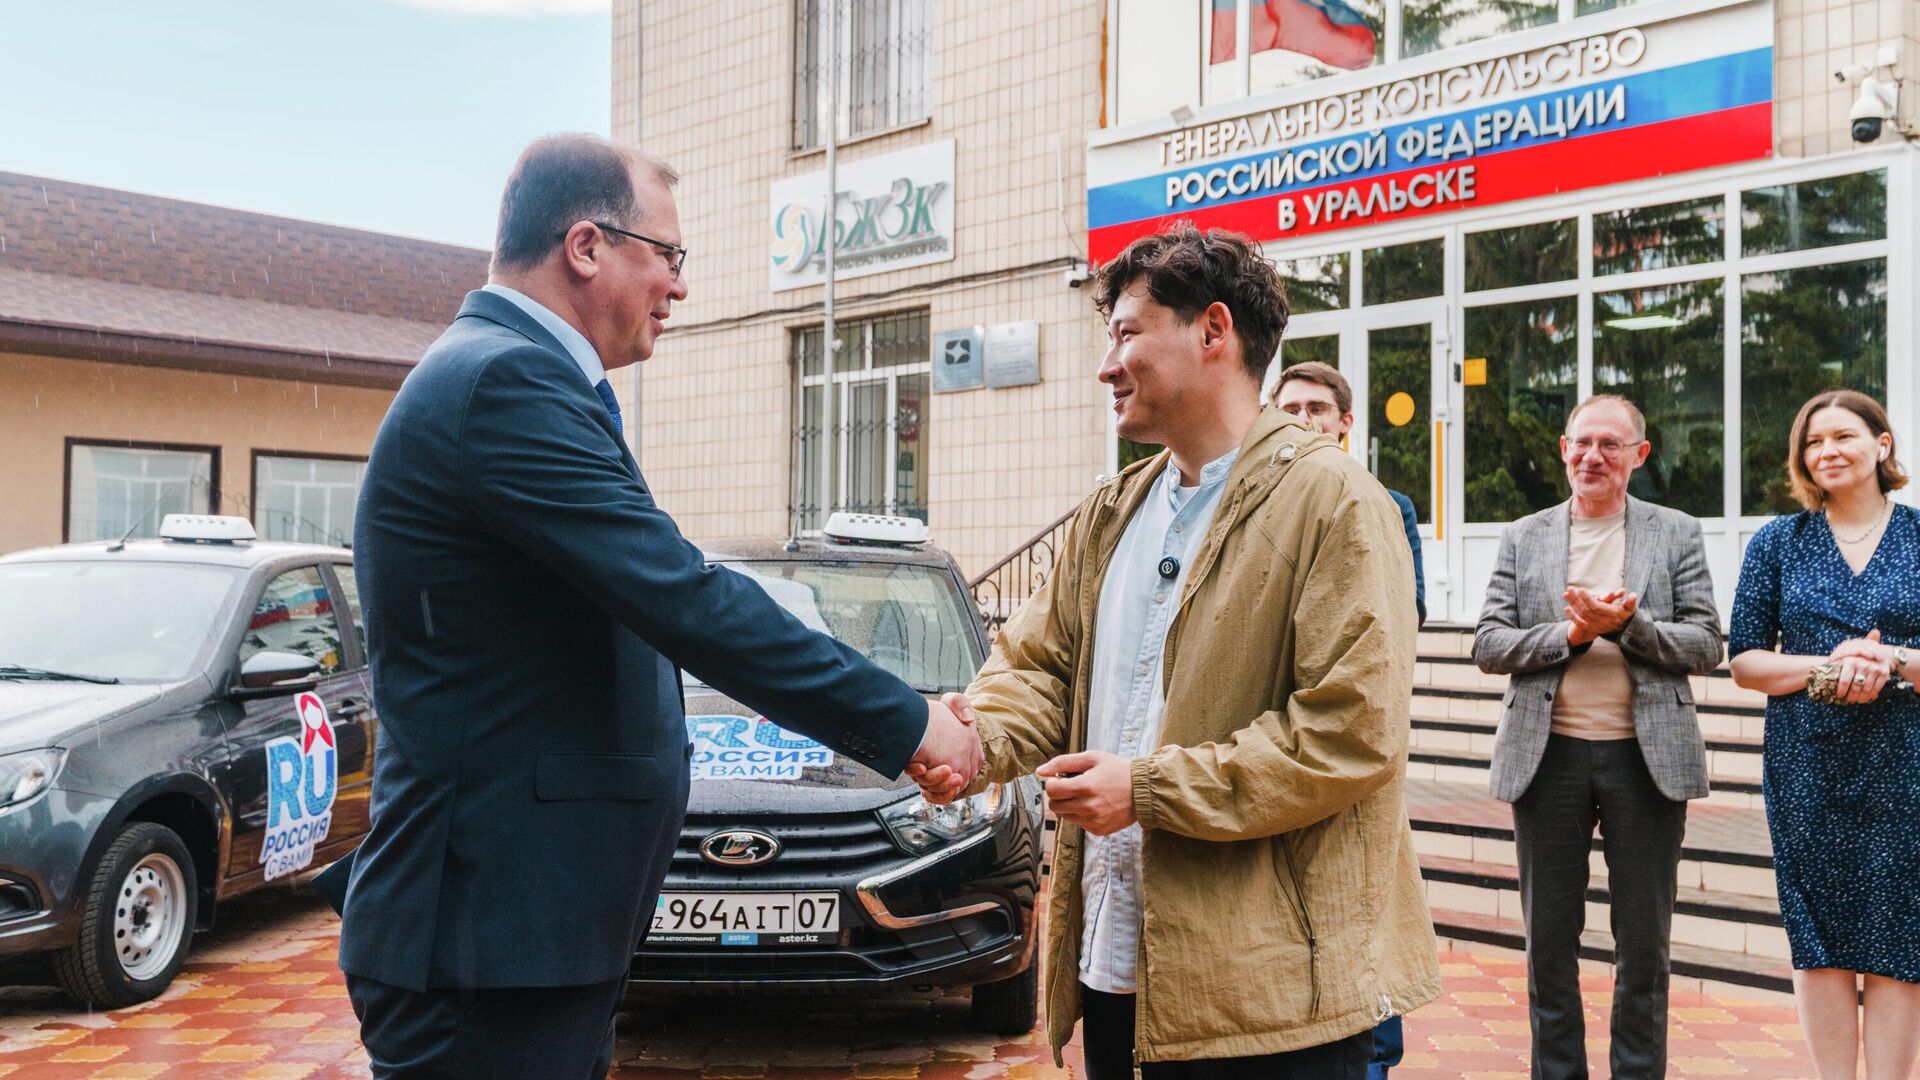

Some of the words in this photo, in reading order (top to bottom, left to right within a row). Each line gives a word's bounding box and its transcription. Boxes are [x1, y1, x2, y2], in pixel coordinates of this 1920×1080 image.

[1159, 91, 1363, 165] ГЕНЕРАЛЬНОЕ
[1373, 28, 1646, 120] КОНСУЛЬСТВО
[1166, 128, 1388, 207] РОССИЙСКОЙ
[1396, 84, 1626, 162] ФЕДЕРАЦИИ
[1278, 198, 1298, 231] В
[1303, 165, 1476, 226] УРАЛЬСКЕ
[691, 750, 827, 764] ОССИЯ
[711, 765, 795, 777] ВАМИ
[269, 743, 335, 829] RU
[264, 816, 329, 858] РОССИЯ
[268, 858, 278, 876] С
[279, 847, 313, 872] ВАМИ
[650, 916, 664, 930] Z
[728, 934, 751, 942] aster
[778, 933, 819, 944] aster.kz
